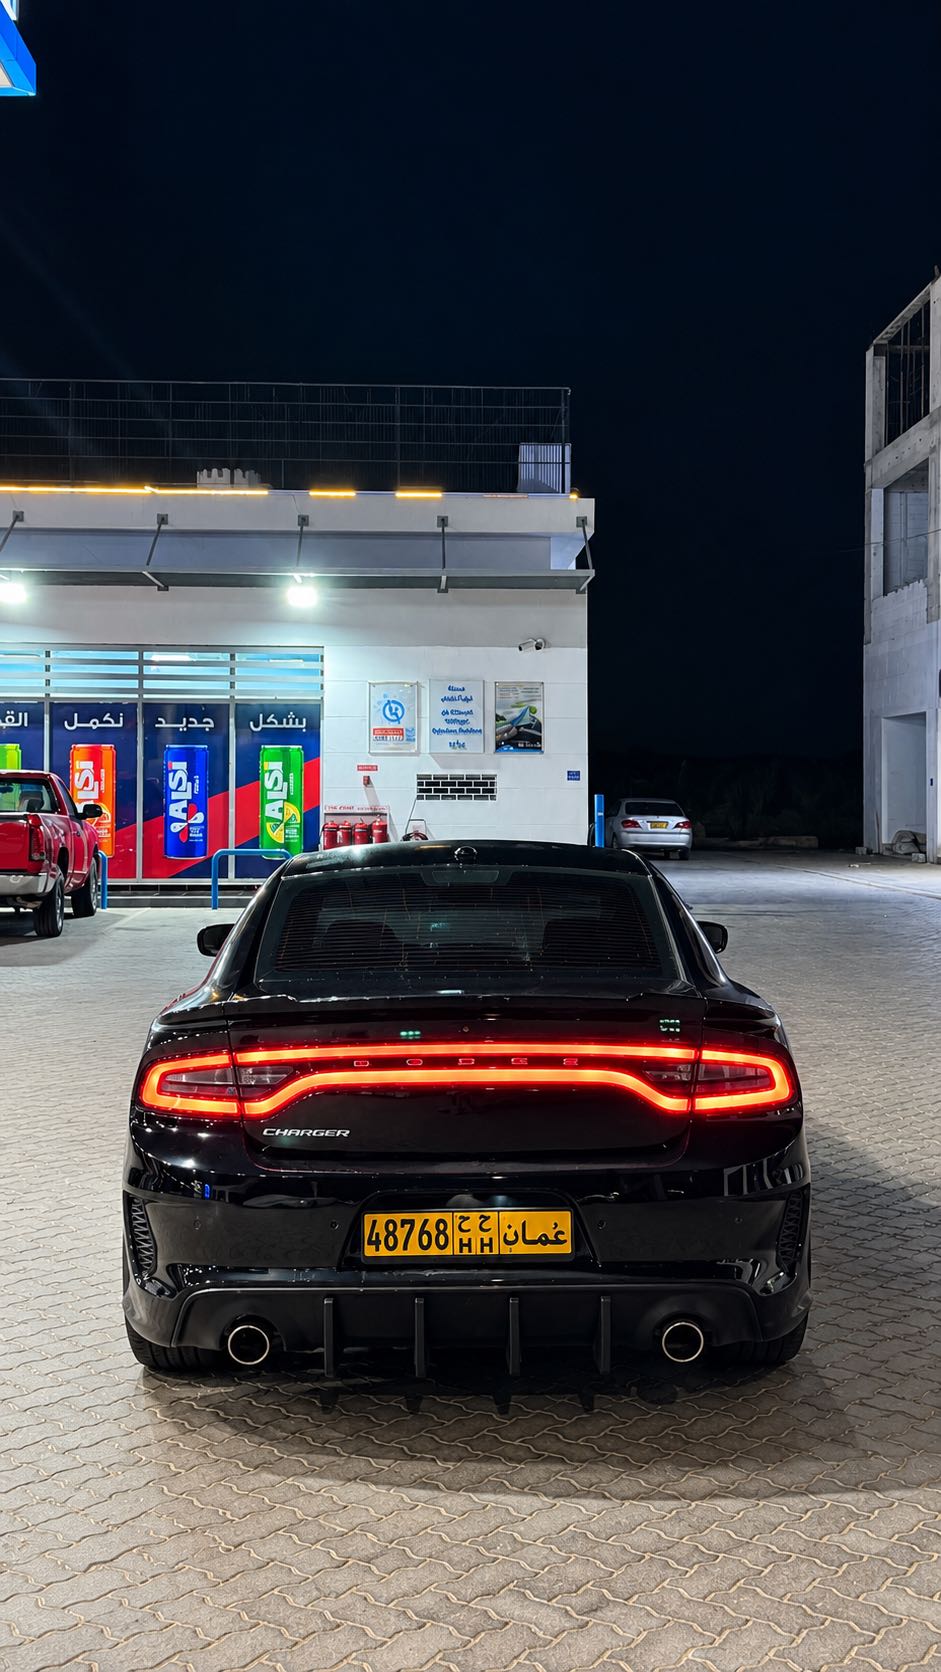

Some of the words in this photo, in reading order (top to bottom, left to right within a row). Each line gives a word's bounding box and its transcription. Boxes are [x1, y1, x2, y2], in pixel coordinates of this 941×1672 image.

[64, 713, 124, 730] نكمل
[155, 717, 215, 731] جديد
[250, 712, 306, 732] بشكل
[262, 1128, 350, 1137] CHARGER
[367, 1218, 449, 1252] 48768
